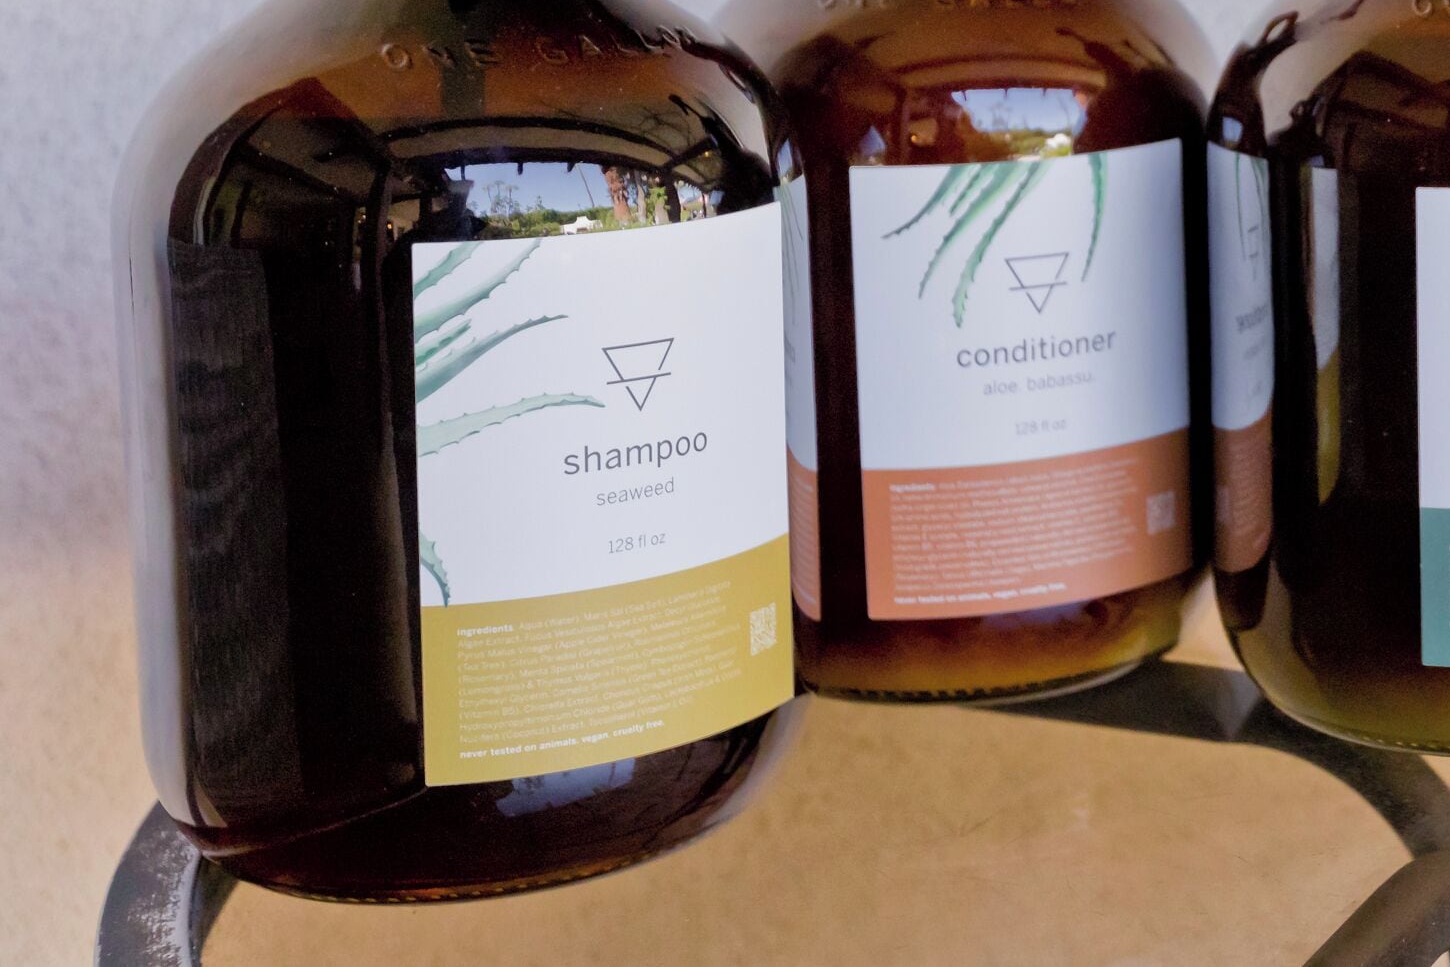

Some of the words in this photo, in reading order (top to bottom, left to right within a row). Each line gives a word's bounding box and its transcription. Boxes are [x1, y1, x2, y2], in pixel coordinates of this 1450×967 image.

[956, 331, 1117, 368] conditioner
[563, 431, 708, 475] shampoo
[595, 476, 675, 506] seaweed
[608, 536, 634, 554] 128
[638, 534, 647, 548] fl
[650, 532, 667, 546] oz
[460, 749, 487, 758] never
[490, 745, 522, 756] tested
[524, 743, 537, 752] on
